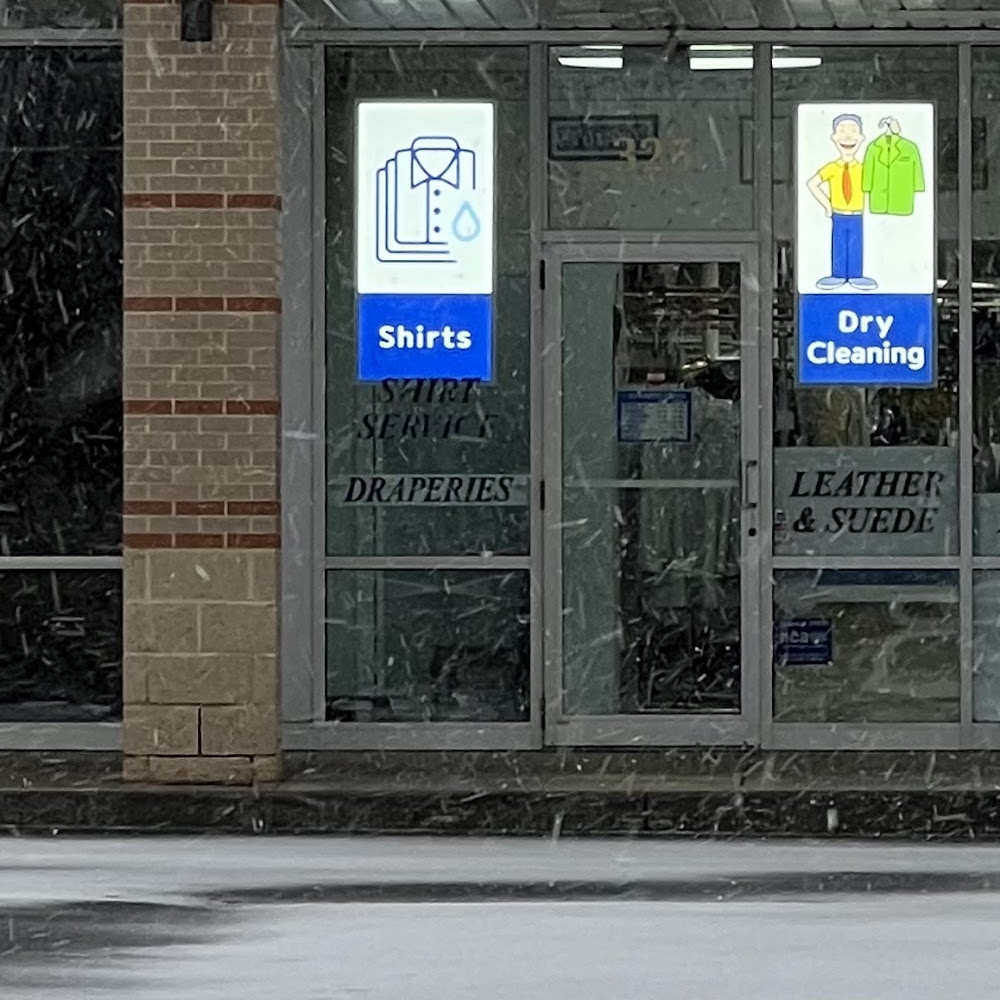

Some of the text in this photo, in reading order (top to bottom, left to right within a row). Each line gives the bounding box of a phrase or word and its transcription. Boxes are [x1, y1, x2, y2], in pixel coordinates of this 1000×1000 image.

[838, 309, 894, 335] Dry
[378, 324, 472, 350] Shirts
[806, 341, 925, 370] Cleaning
[381, 377, 481, 403] SHIRT
[357, 414, 499, 439] SERVICE
[344, 476, 514, 503] DRAPERIES
[790, 471, 944, 497] LEATHER
[793, 506, 940, 533] & SUEDE
